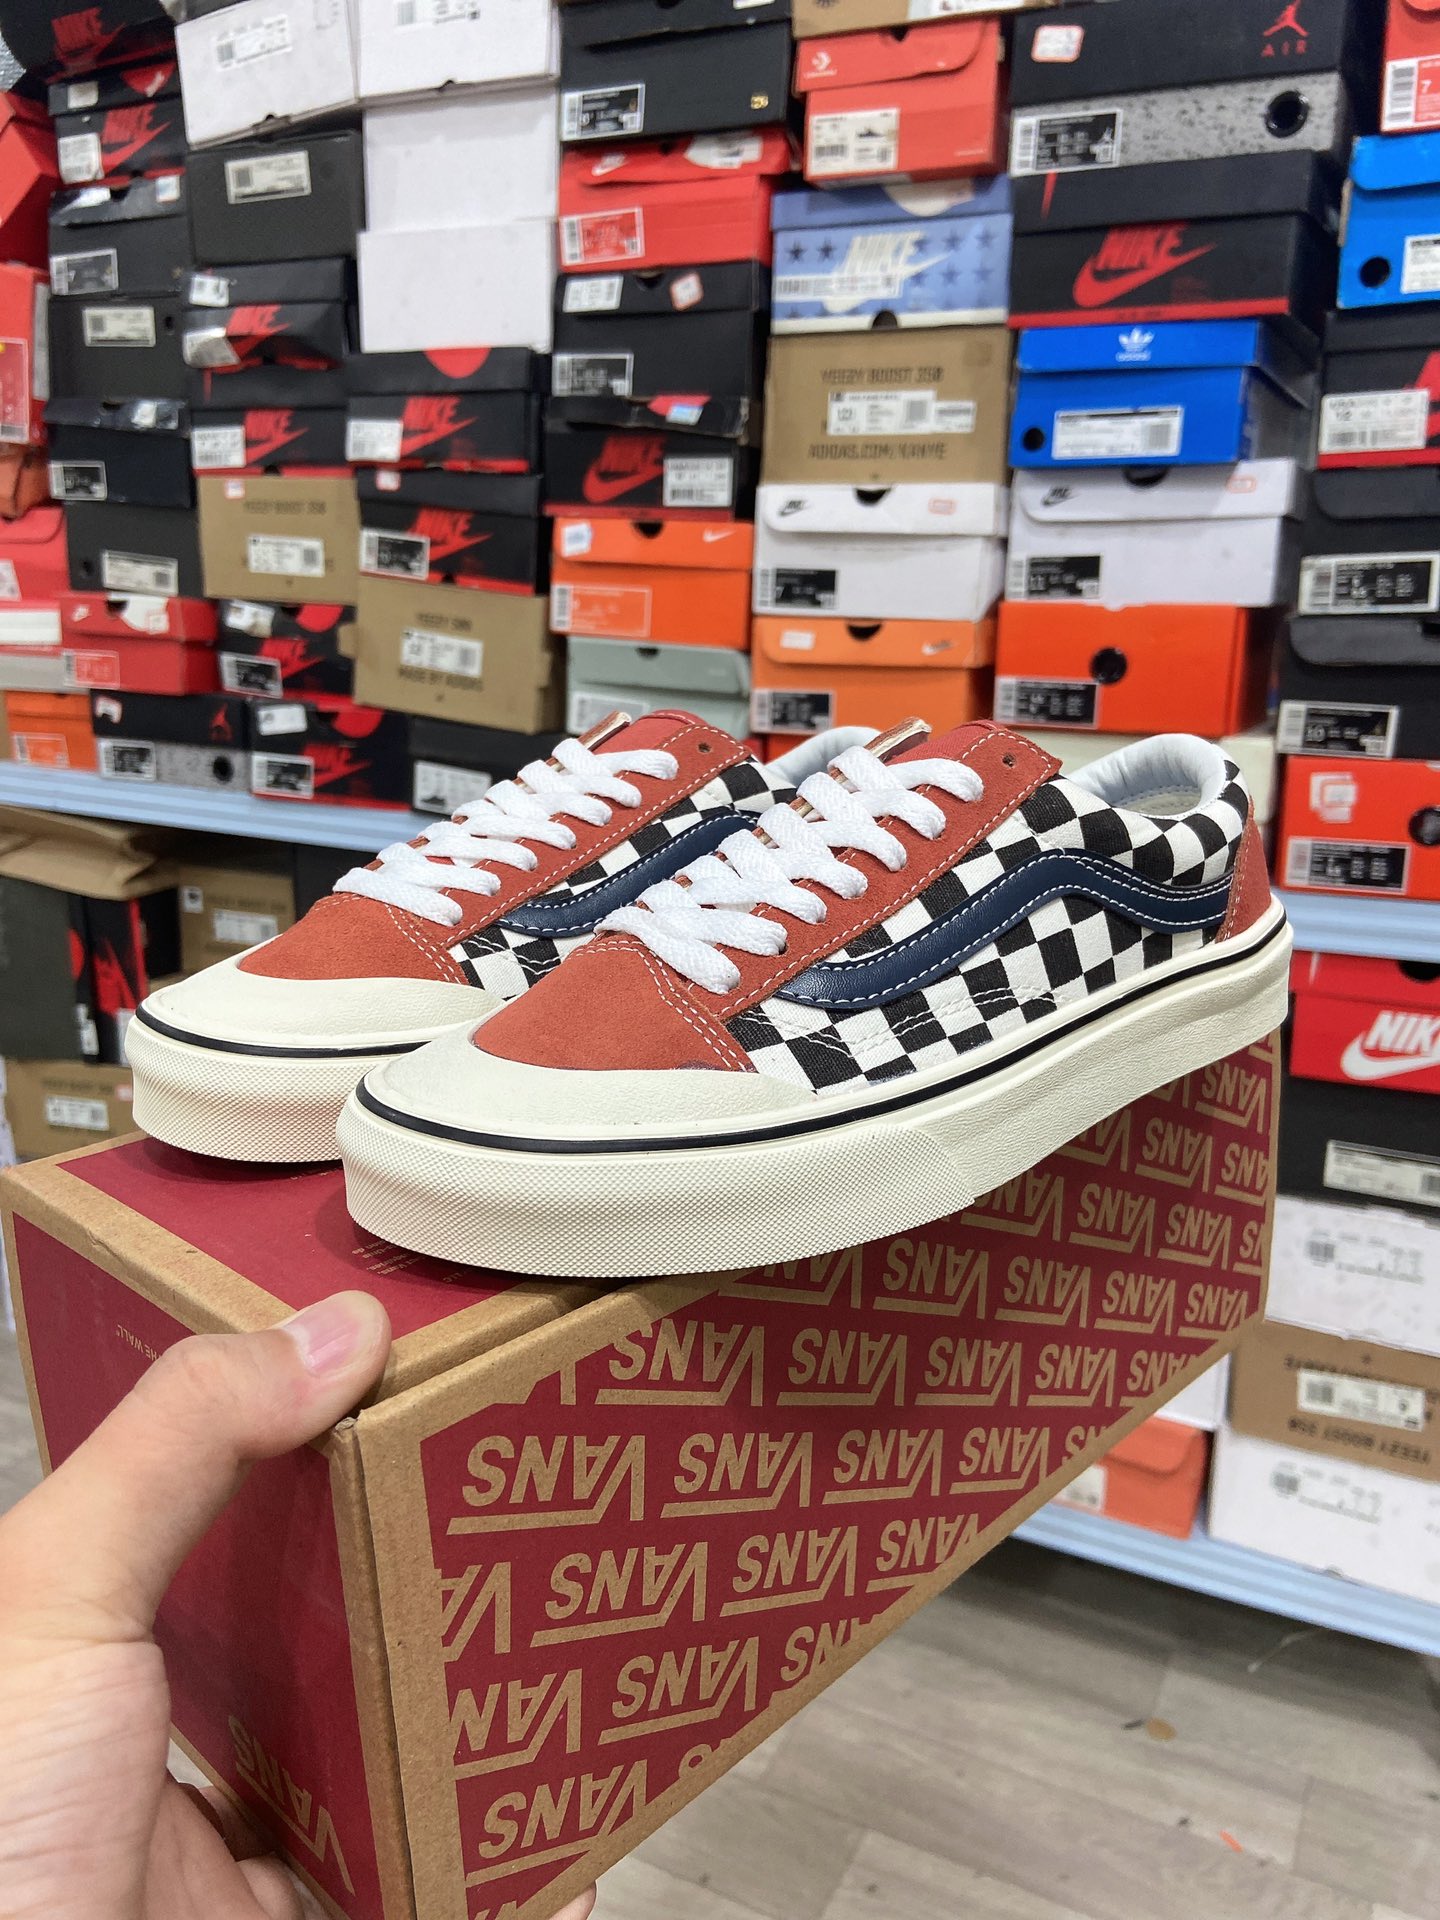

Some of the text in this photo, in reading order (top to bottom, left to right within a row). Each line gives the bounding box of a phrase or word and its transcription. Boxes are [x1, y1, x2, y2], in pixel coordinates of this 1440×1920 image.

[1096, 221, 1189, 270] NIKE
[402, 395, 461, 430] NIKE
[1364, 1009, 1440, 1056] NIK
[1195, 1062, 1267, 1135] VANS
[1135, 1117, 1214, 1194] VANS
[1215, 1142, 1271, 1208] ANS
[960, 1170, 1065, 1242] VAN
[1068, 1183, 1156, 1257] VANS
[1157, 1203, 1233, 1271] VANS
[873, 1238, 989, 1320] VANS
[994, 1256, 1092, 1328] VANS
[1094, 1270, 1177, 1336] VANS
[1178, 1281, 1249, 1339] VANS
[144, 1343, 162, 1362] HE
[594, 1318, 765, 1406] VANS
[776, 1328, 908, 1407] VANS
[914, 1336, 1023, 1407] VANS
[1026, 1343, 1117, 1408] VANS
[446, 1435, 646, 1535] VANS
[660, 1432, 814, 1519] VANS
[822, 1428, 944, 1505] VANS
[949, 1426, 1051, 1495] VANS
[441, 1561, 512, 1663] VA
[529, 1542, 709, 1648] VANS
[719, 1526, 859, 1618] VANS
[450, 1668, 583, 1782] VAN
[598, 1636, 759, 1746] VANS
[228, 1714, 356, 1898] VANS
[465, 1758, 648, 1889] VANS
